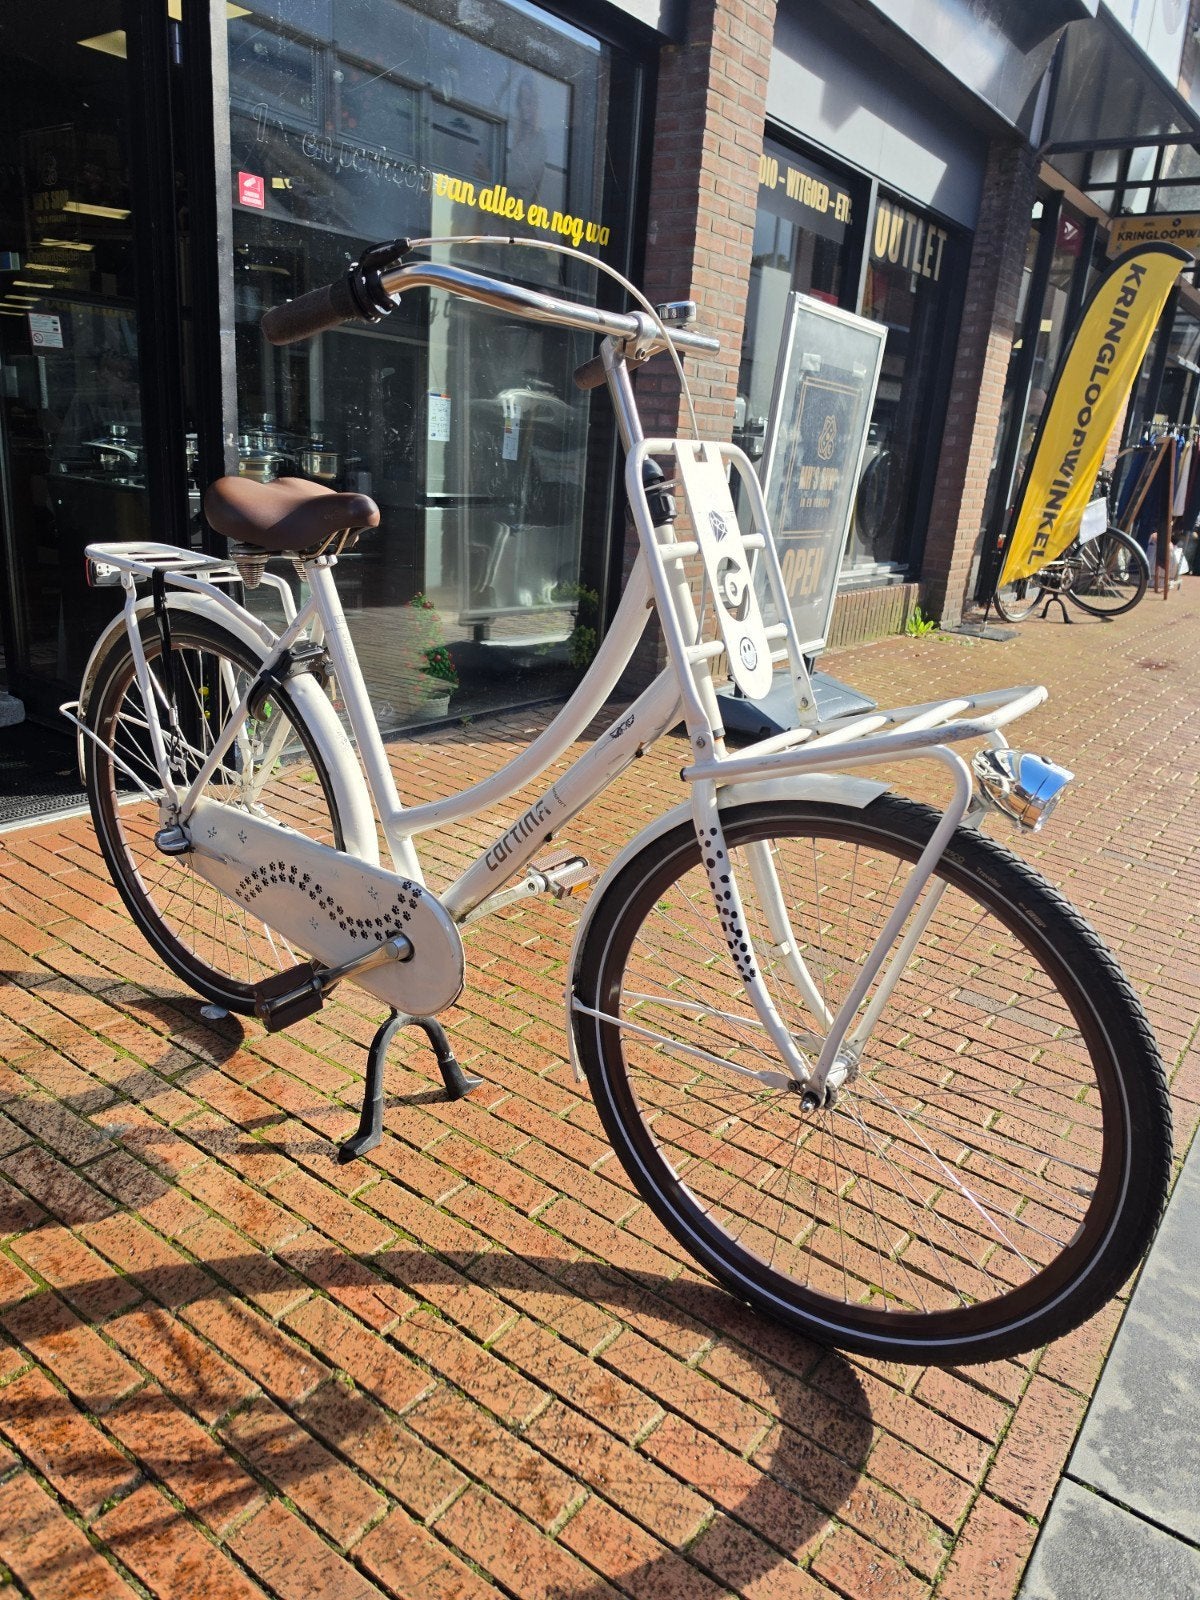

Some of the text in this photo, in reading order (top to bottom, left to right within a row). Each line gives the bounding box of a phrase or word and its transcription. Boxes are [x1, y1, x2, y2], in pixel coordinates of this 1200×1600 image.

[435, 173, 477, 207] van
[478, 184, 526, 221] alles
[527, 203, 551, 230] en
[551, 210, 585, 248] nog
[785, 166, 831, 214] WITGOED
[873, 199, 948, 282] OUTLET
[1027, 262, 1148, 566] KRINGLOOPWINKEL
[781, 546, 826, 599] OPEN
